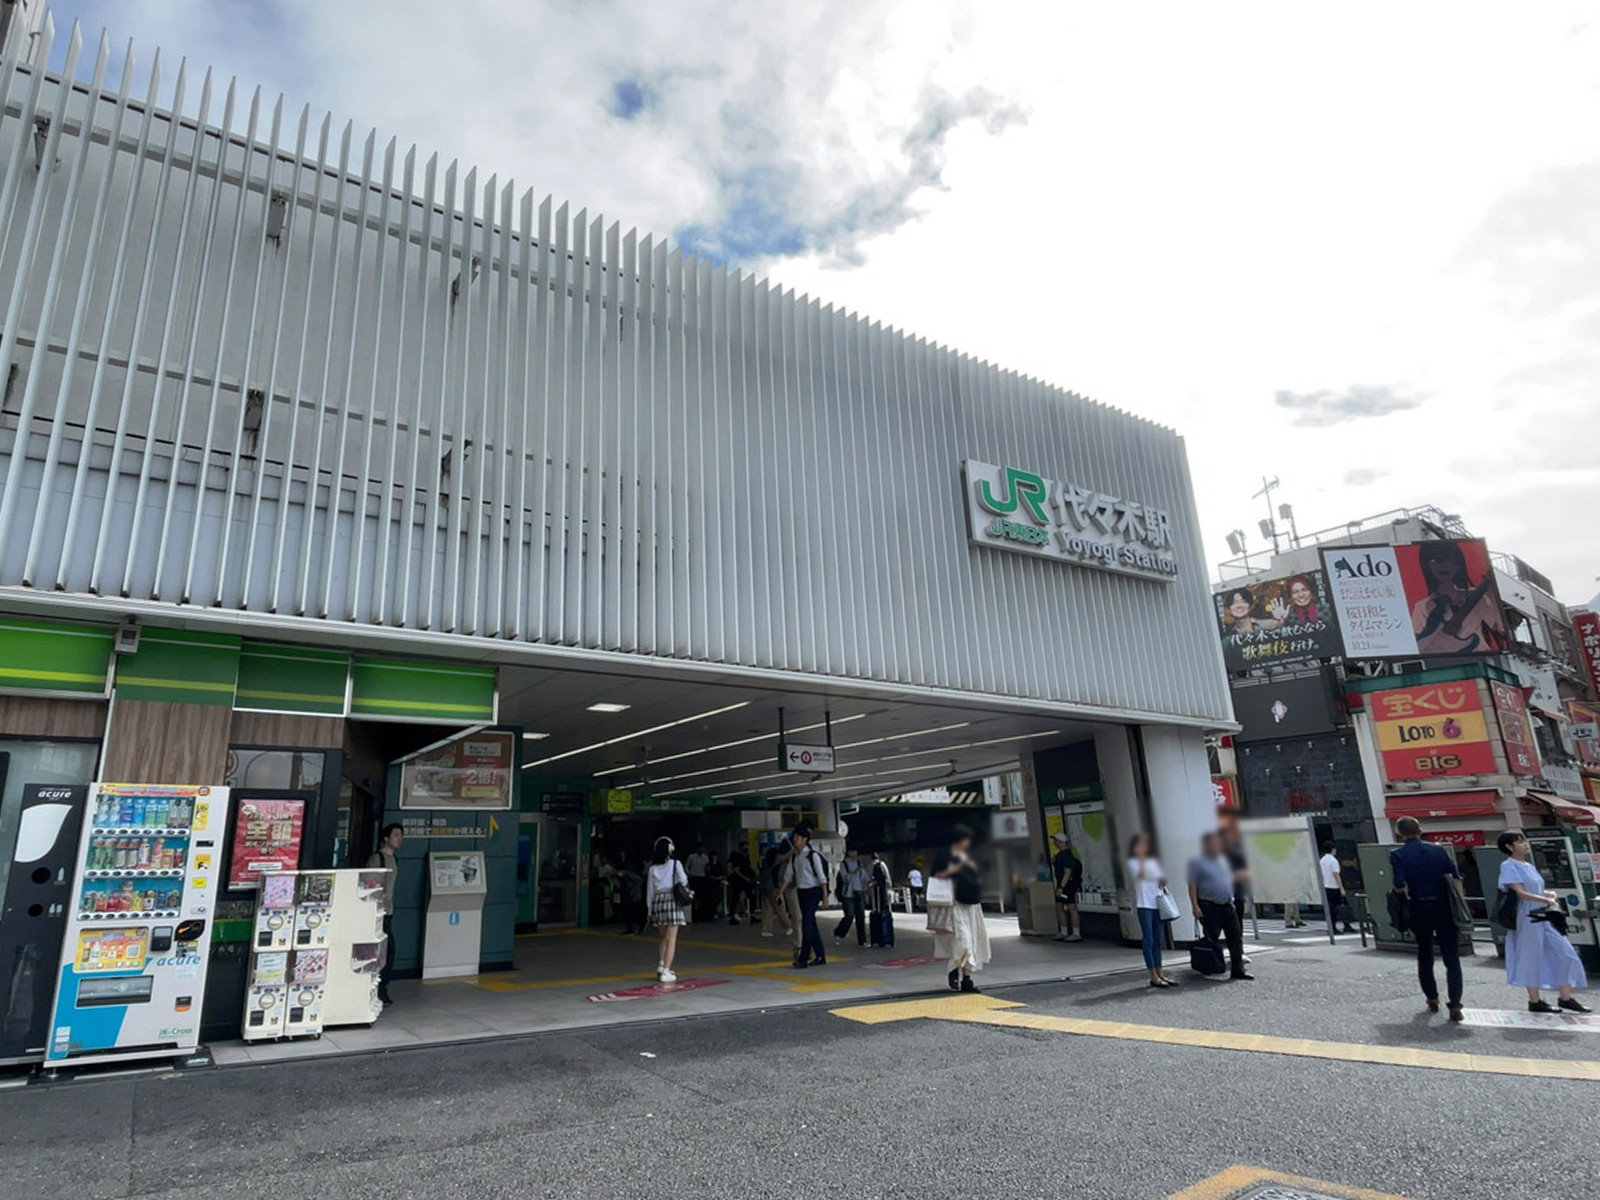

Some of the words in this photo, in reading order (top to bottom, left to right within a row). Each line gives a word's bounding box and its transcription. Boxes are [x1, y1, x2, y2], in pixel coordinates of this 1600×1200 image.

[980, 467, 1050, 523] JR
[1053, 480, 1174, 548] 代々木駅
[1061, 528, 1118, 564] Yoyogi
[1119, 546, 1178, 577] Station
[1335, 553, 1392, 579] Ado
[1382, 686, 1467, 718] 宝くじ
[1398, 723, 1436, 744] LOTO
[1441, 716, 1462, 740] 6
[156, 956, 202, 967] acure
